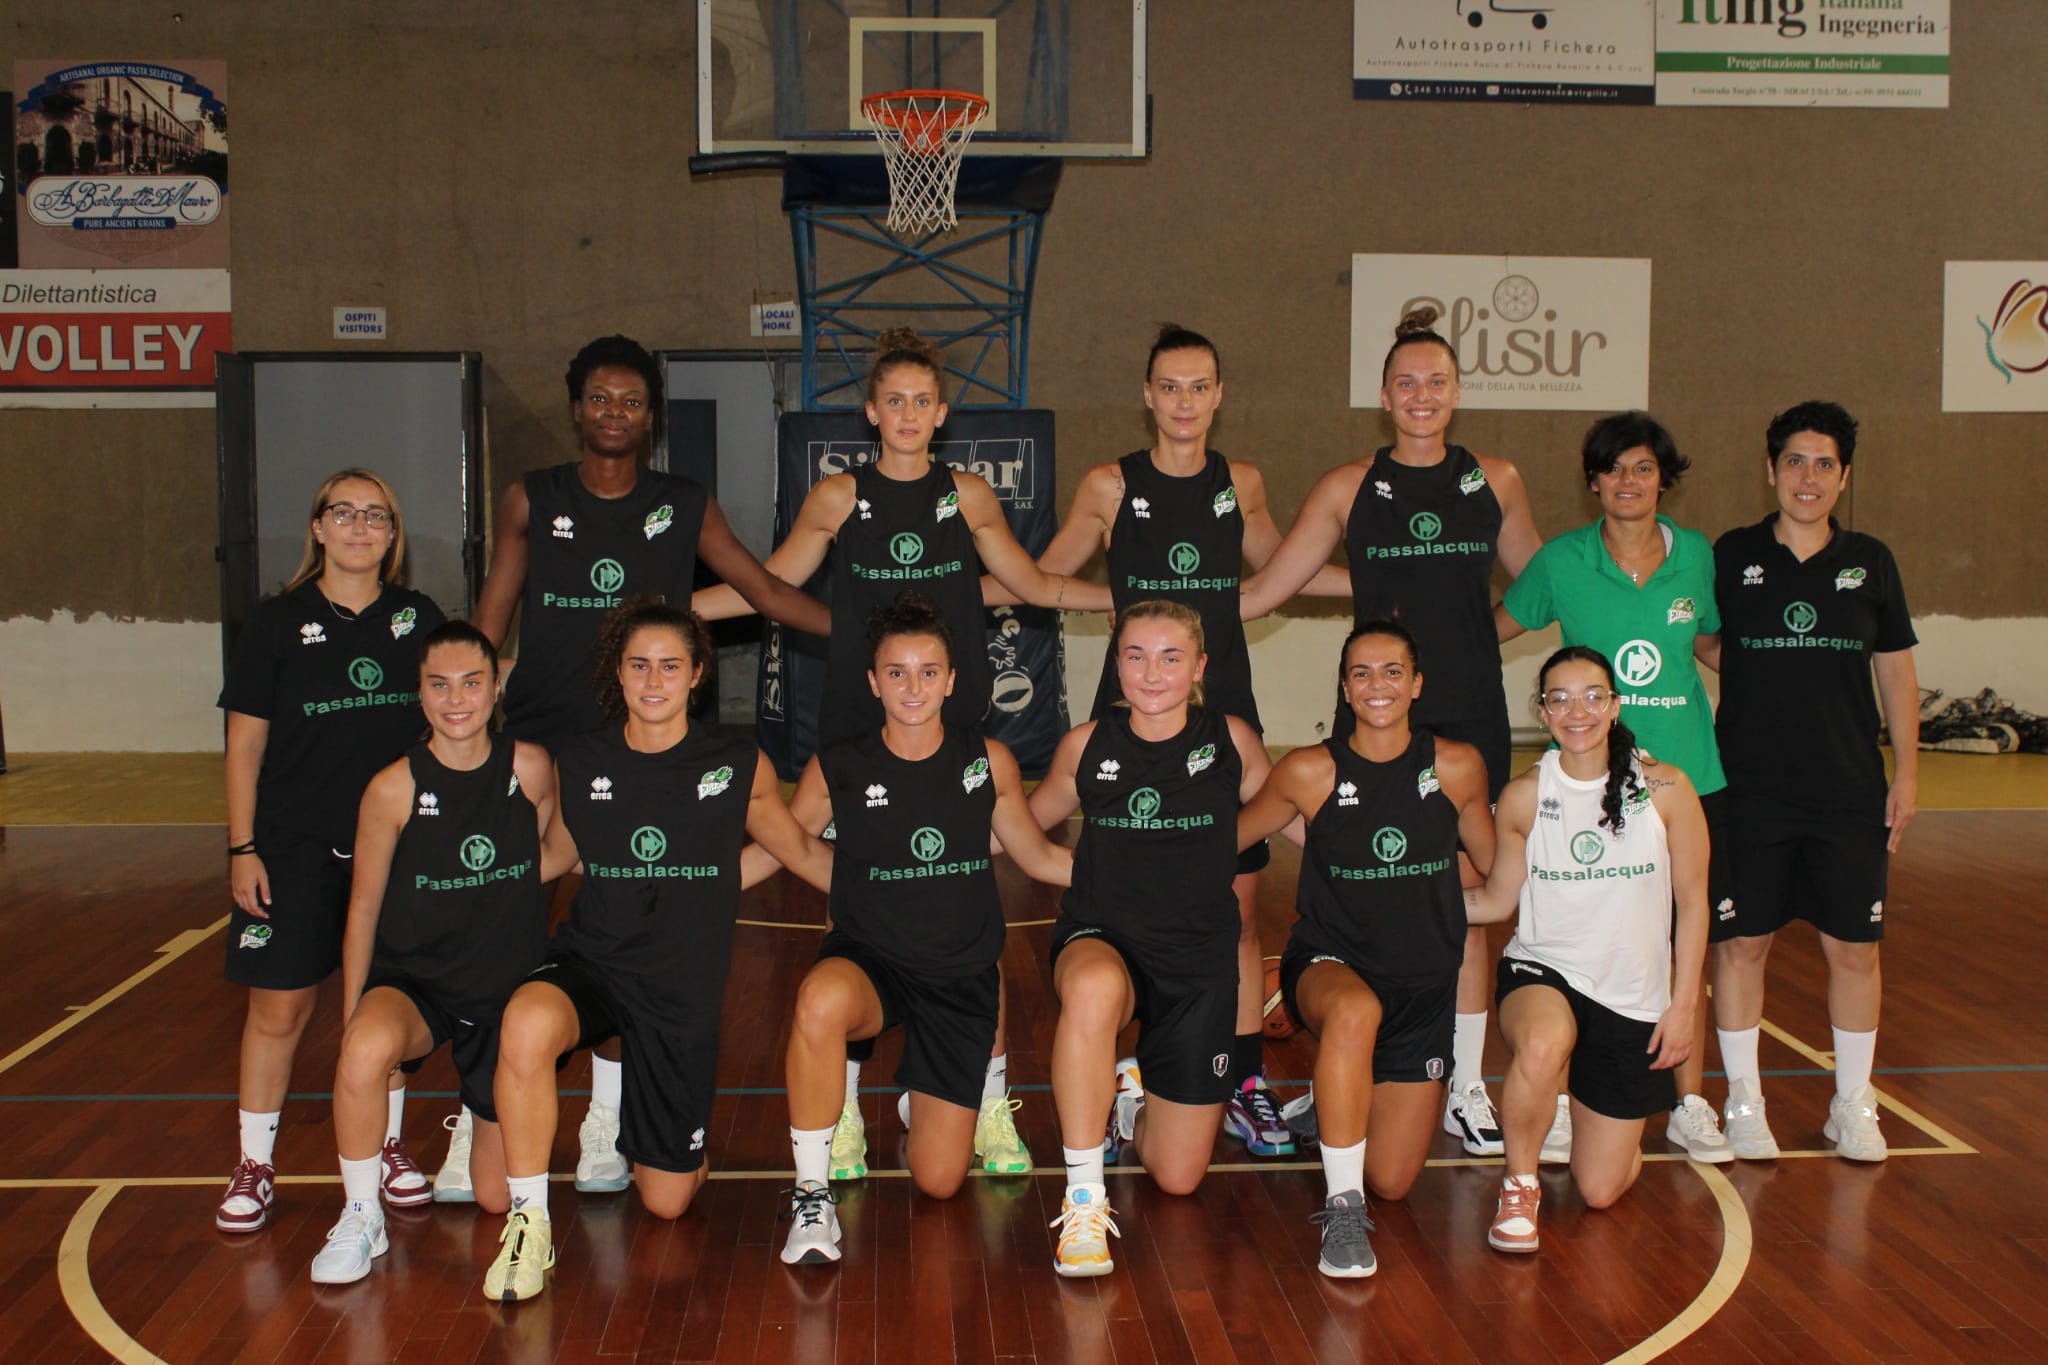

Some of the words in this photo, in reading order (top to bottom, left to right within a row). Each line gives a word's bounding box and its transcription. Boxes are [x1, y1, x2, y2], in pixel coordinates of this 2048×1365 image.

[1820, 14, 1936, 38] Ingegneria
[1395, 36, 1531, 53] Autotrasporti
[1543, 40, 1616, 55] Fichera
[1727, 55, 1811, 71] Progettazione
[1815, 56, 1882, 71] Industriale
[59, 67, 96, 82] ARTISANAL
[96, 65, 127, 76] ORGANIC
[127, 65, 148, 75] PASTA
[149, 67, 185, 83] SELECTION
[83, 219, 103, 229] PURE
[104, 219, 136, 229] ANCIENT
[138, 219, 166, 229] GRAINS
[3, 284, 158, 304] Dilettantistica
[344, 313, 376, 321] OSPITI
[763, 310, 794, 319] OCALI
[339, 324, 382, 333] VISITORS
[763, 321, 791, 330] HOME
[1487, 382, 1514, 391] DELLA
[1517, 382, 1536, 392] TUA
[1539, 383, 1583, 392] BELLEZZA
[1013, 501, 1034, 510] S.A.S.
[1366, 541, 1489, 560] Passalacqua
[1127, 575, 1238, 591] Passalacqua
[543, 593, 630, 608] Passala
[1740, 634, 1864, 651] Passalacqua
[1620, 693, 1687, 710] alacqua
[588, 863, 719, 881] Passalacqua
[869, 858, 989, 881] Passalacqua
[1329, 858, 1450, 880] Passalacqua
[1531, 862, 1655, 881] Passalacqua
